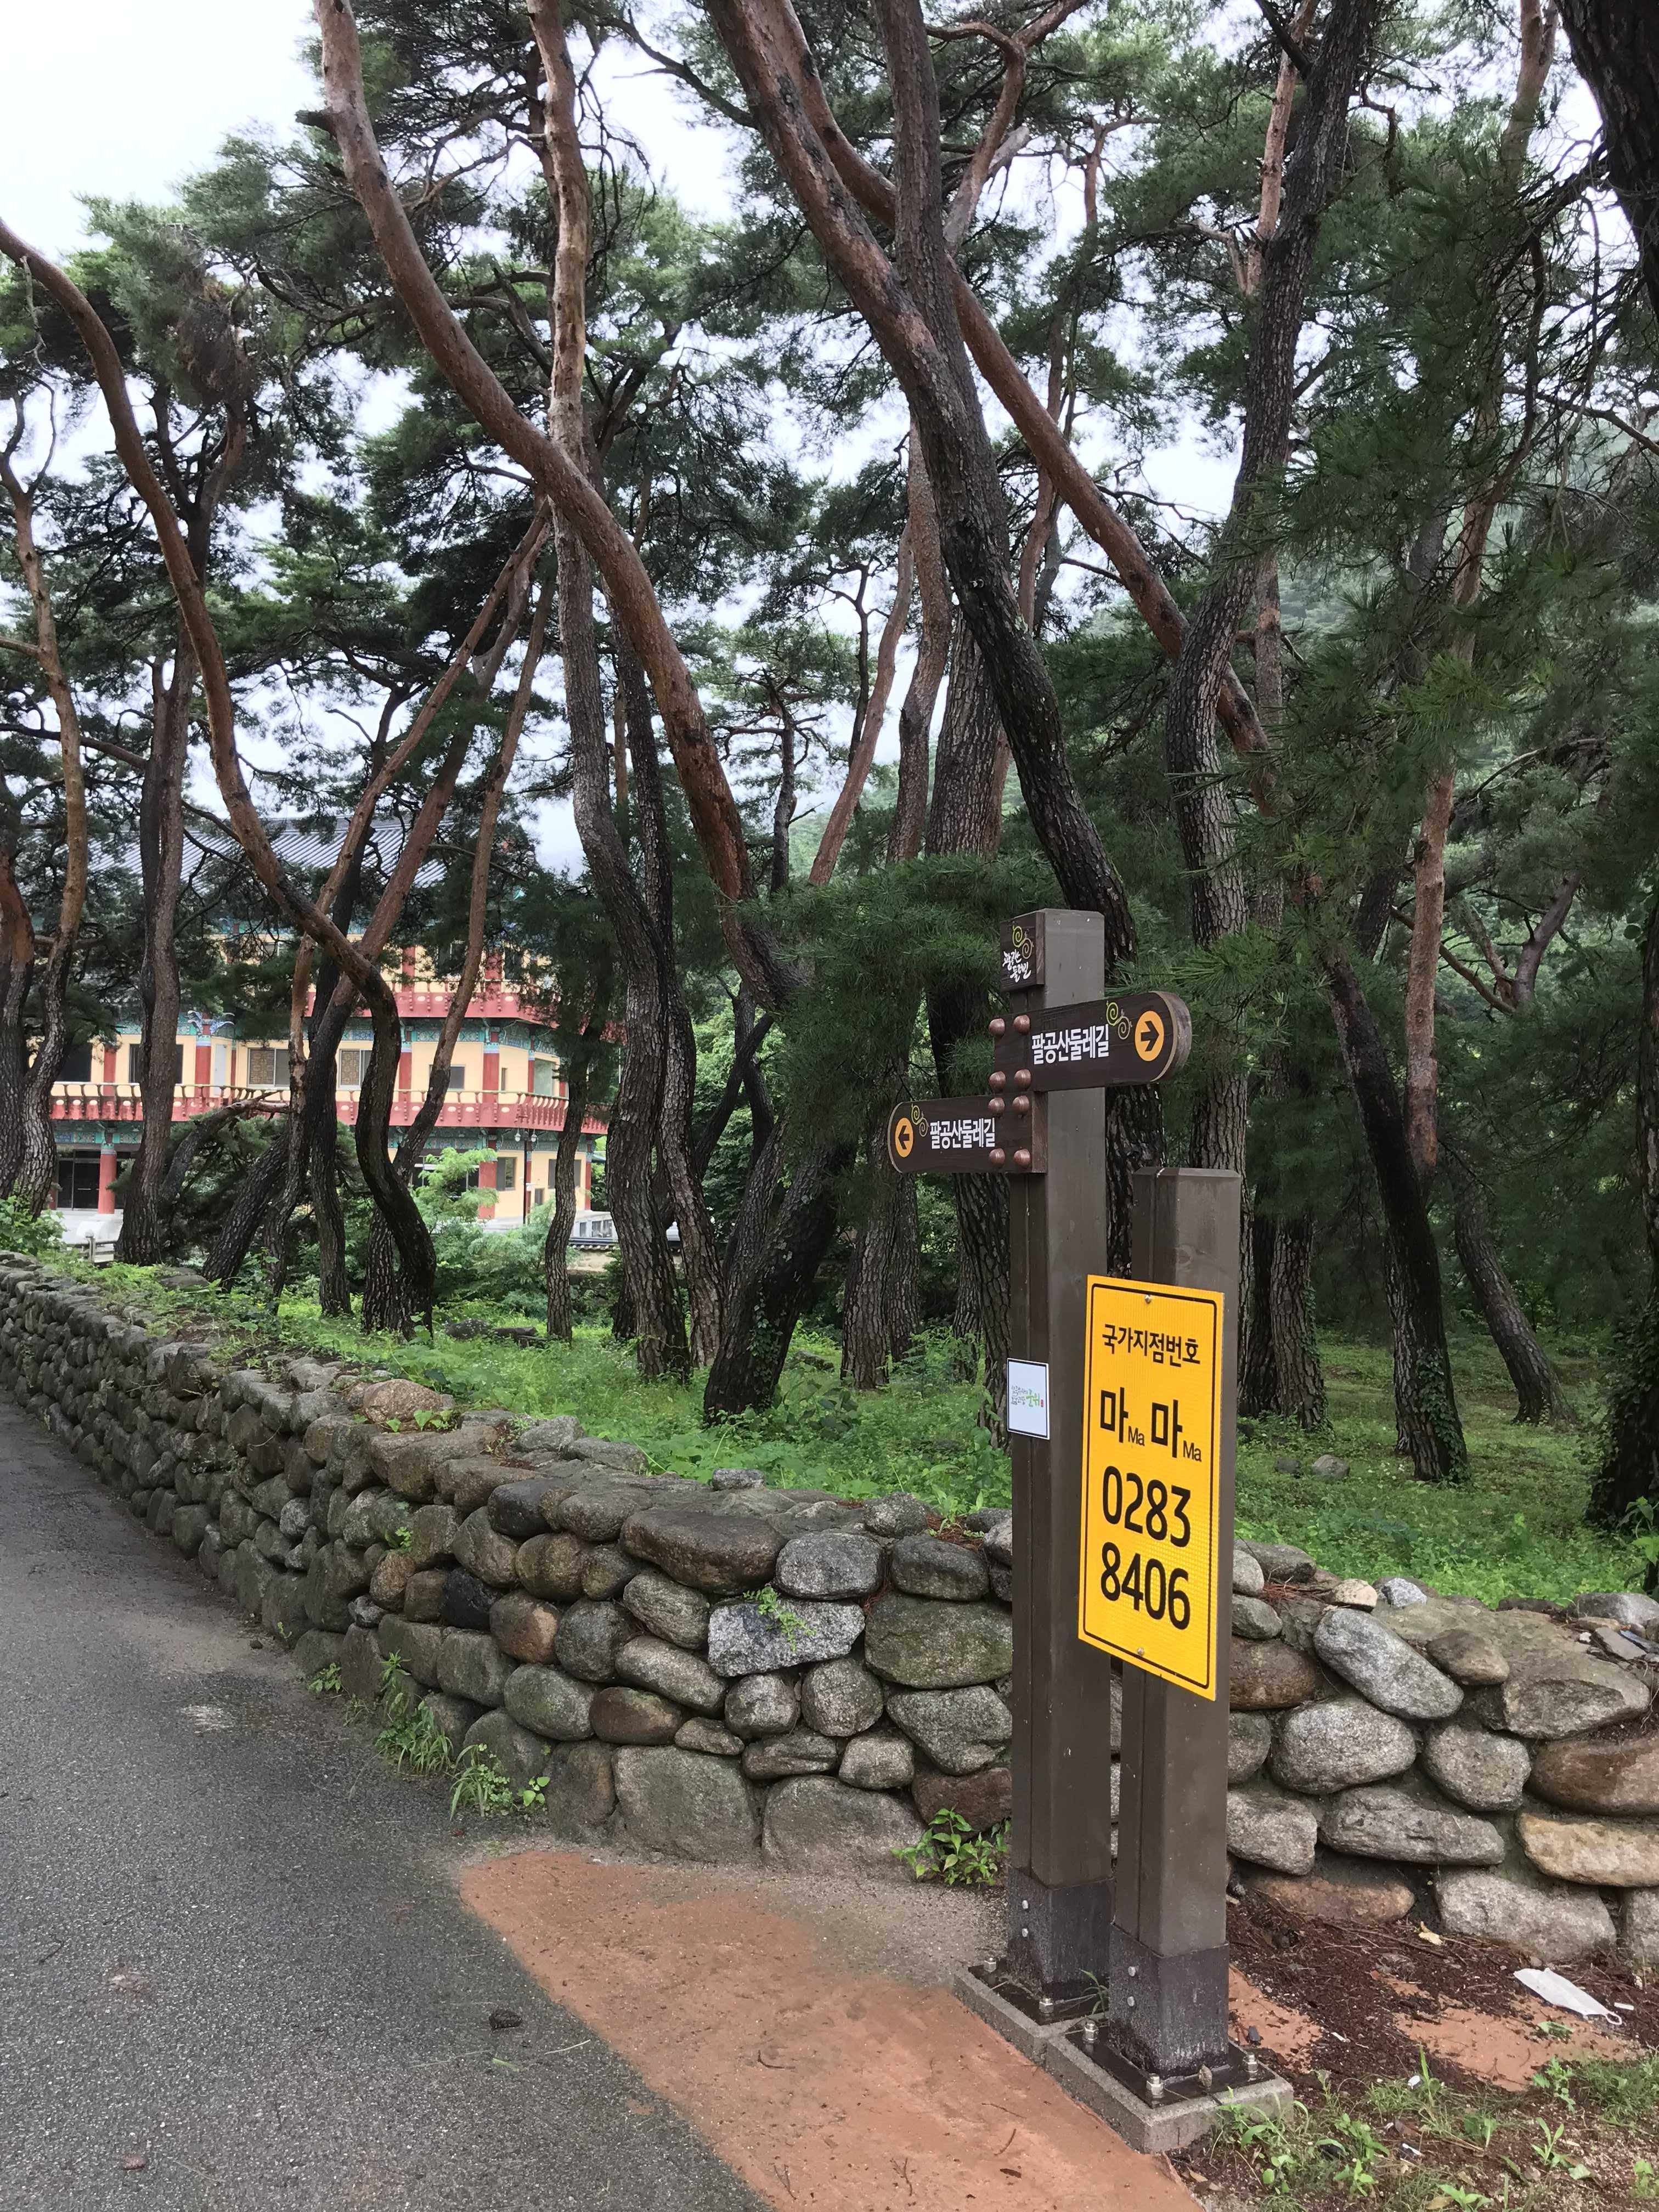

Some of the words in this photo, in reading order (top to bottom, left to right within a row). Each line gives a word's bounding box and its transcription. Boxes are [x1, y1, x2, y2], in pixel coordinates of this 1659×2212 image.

[1032, 1024, 1109, 1064] 팔공산둘레길
[930, 1118, 995, 1149] 팔공산둘레길
[1102, 1324, 1200, 1367] 국가지점번호
[1101, 1387, 1128, 1443] 마
[1128, 1426, 1145, 1446] Ma
[1151, 1400, 1183, 1458] 마
[1183, 1440, 1201, 1462] Ma
[1103, 1466, 1190, 1547] 0283
[1101, 1542, 1190, 1630] 8406
